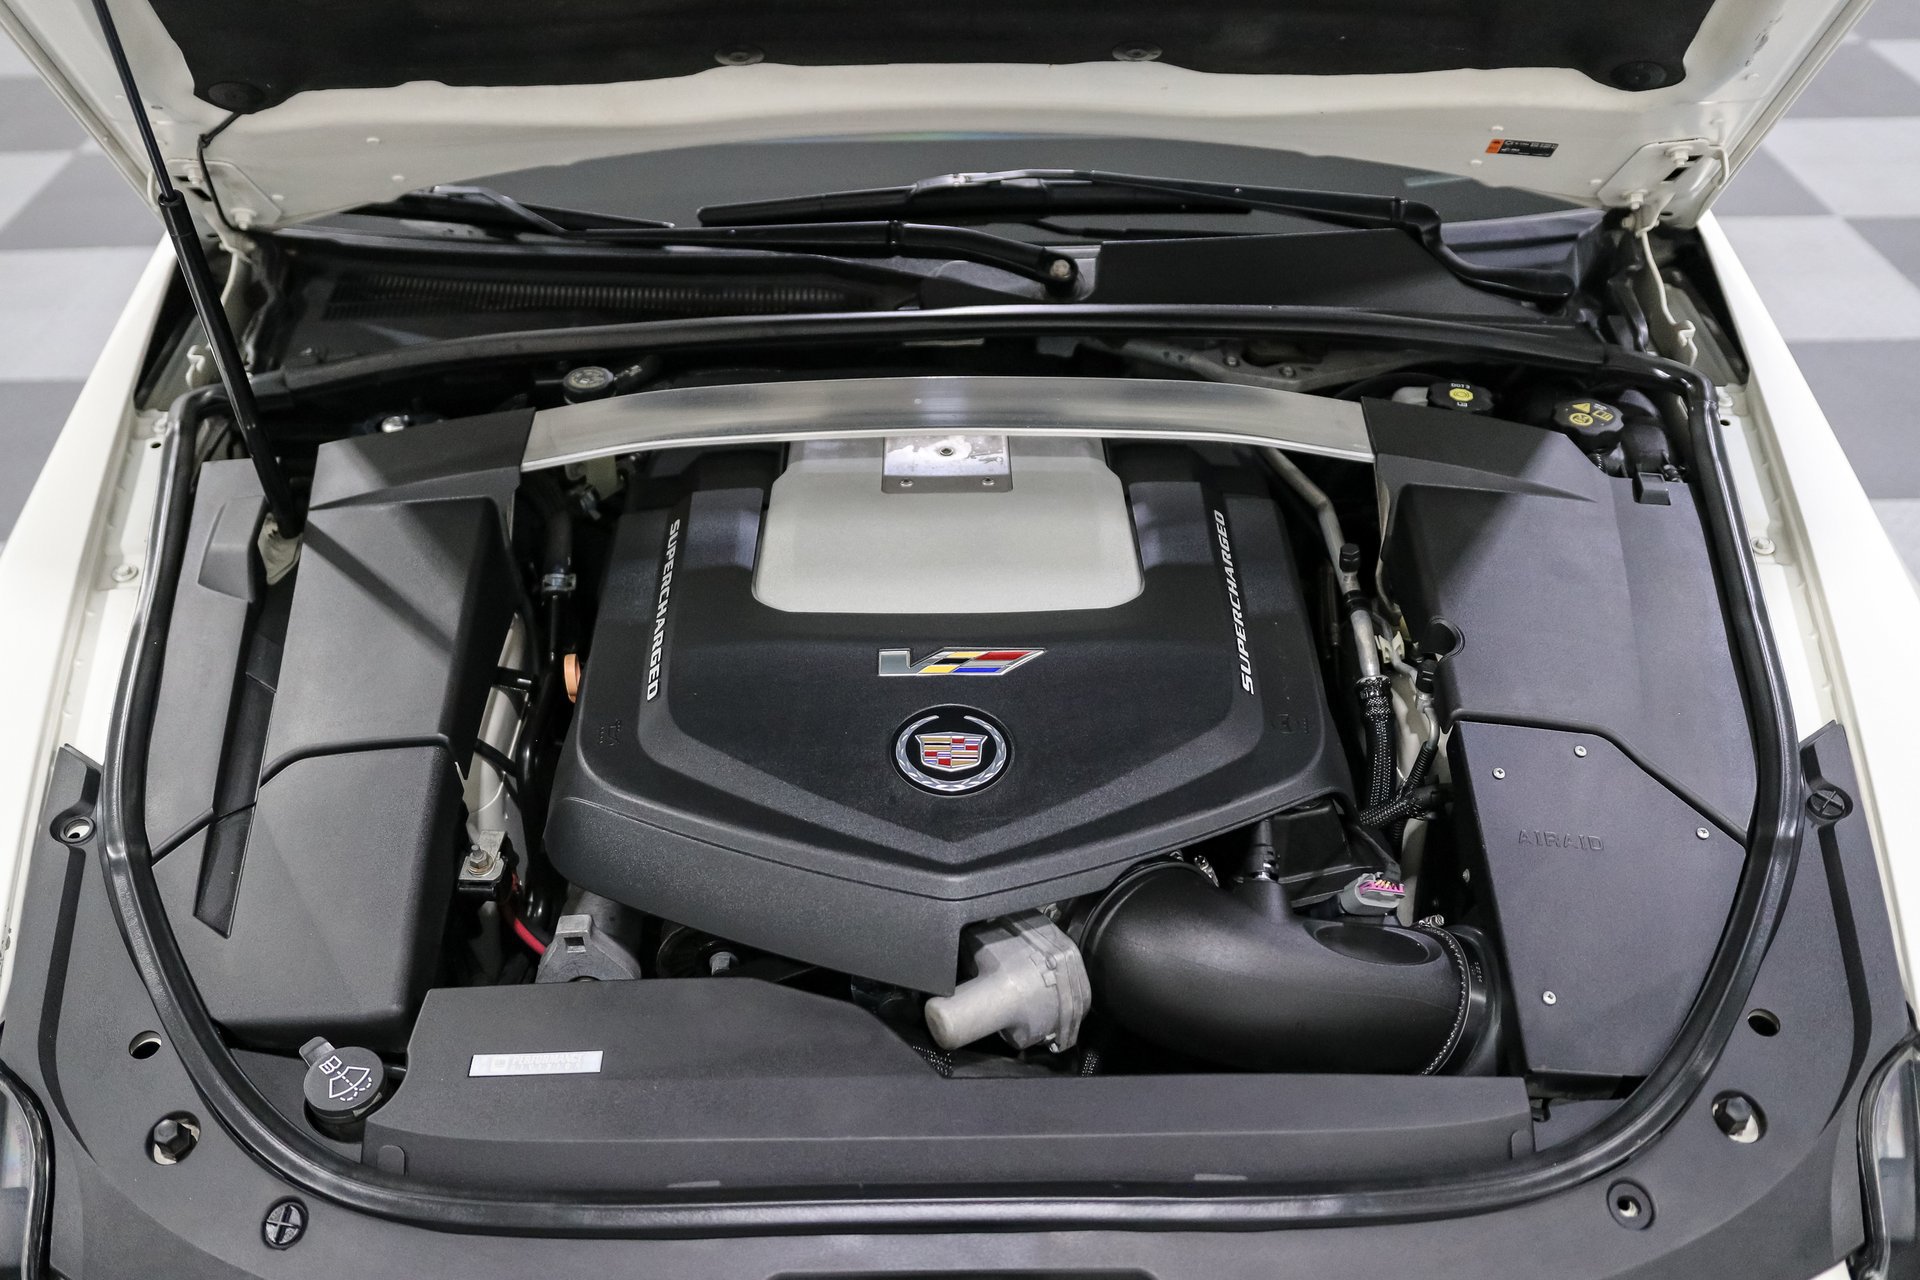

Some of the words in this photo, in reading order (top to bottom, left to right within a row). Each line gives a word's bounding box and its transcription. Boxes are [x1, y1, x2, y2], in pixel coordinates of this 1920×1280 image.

[647, 518, 681, 701] SUPERCHARGED
[1214, 509, 1255, 696] SUPERCHARGED
[1519, 829, 1605, 851] AIRAID
